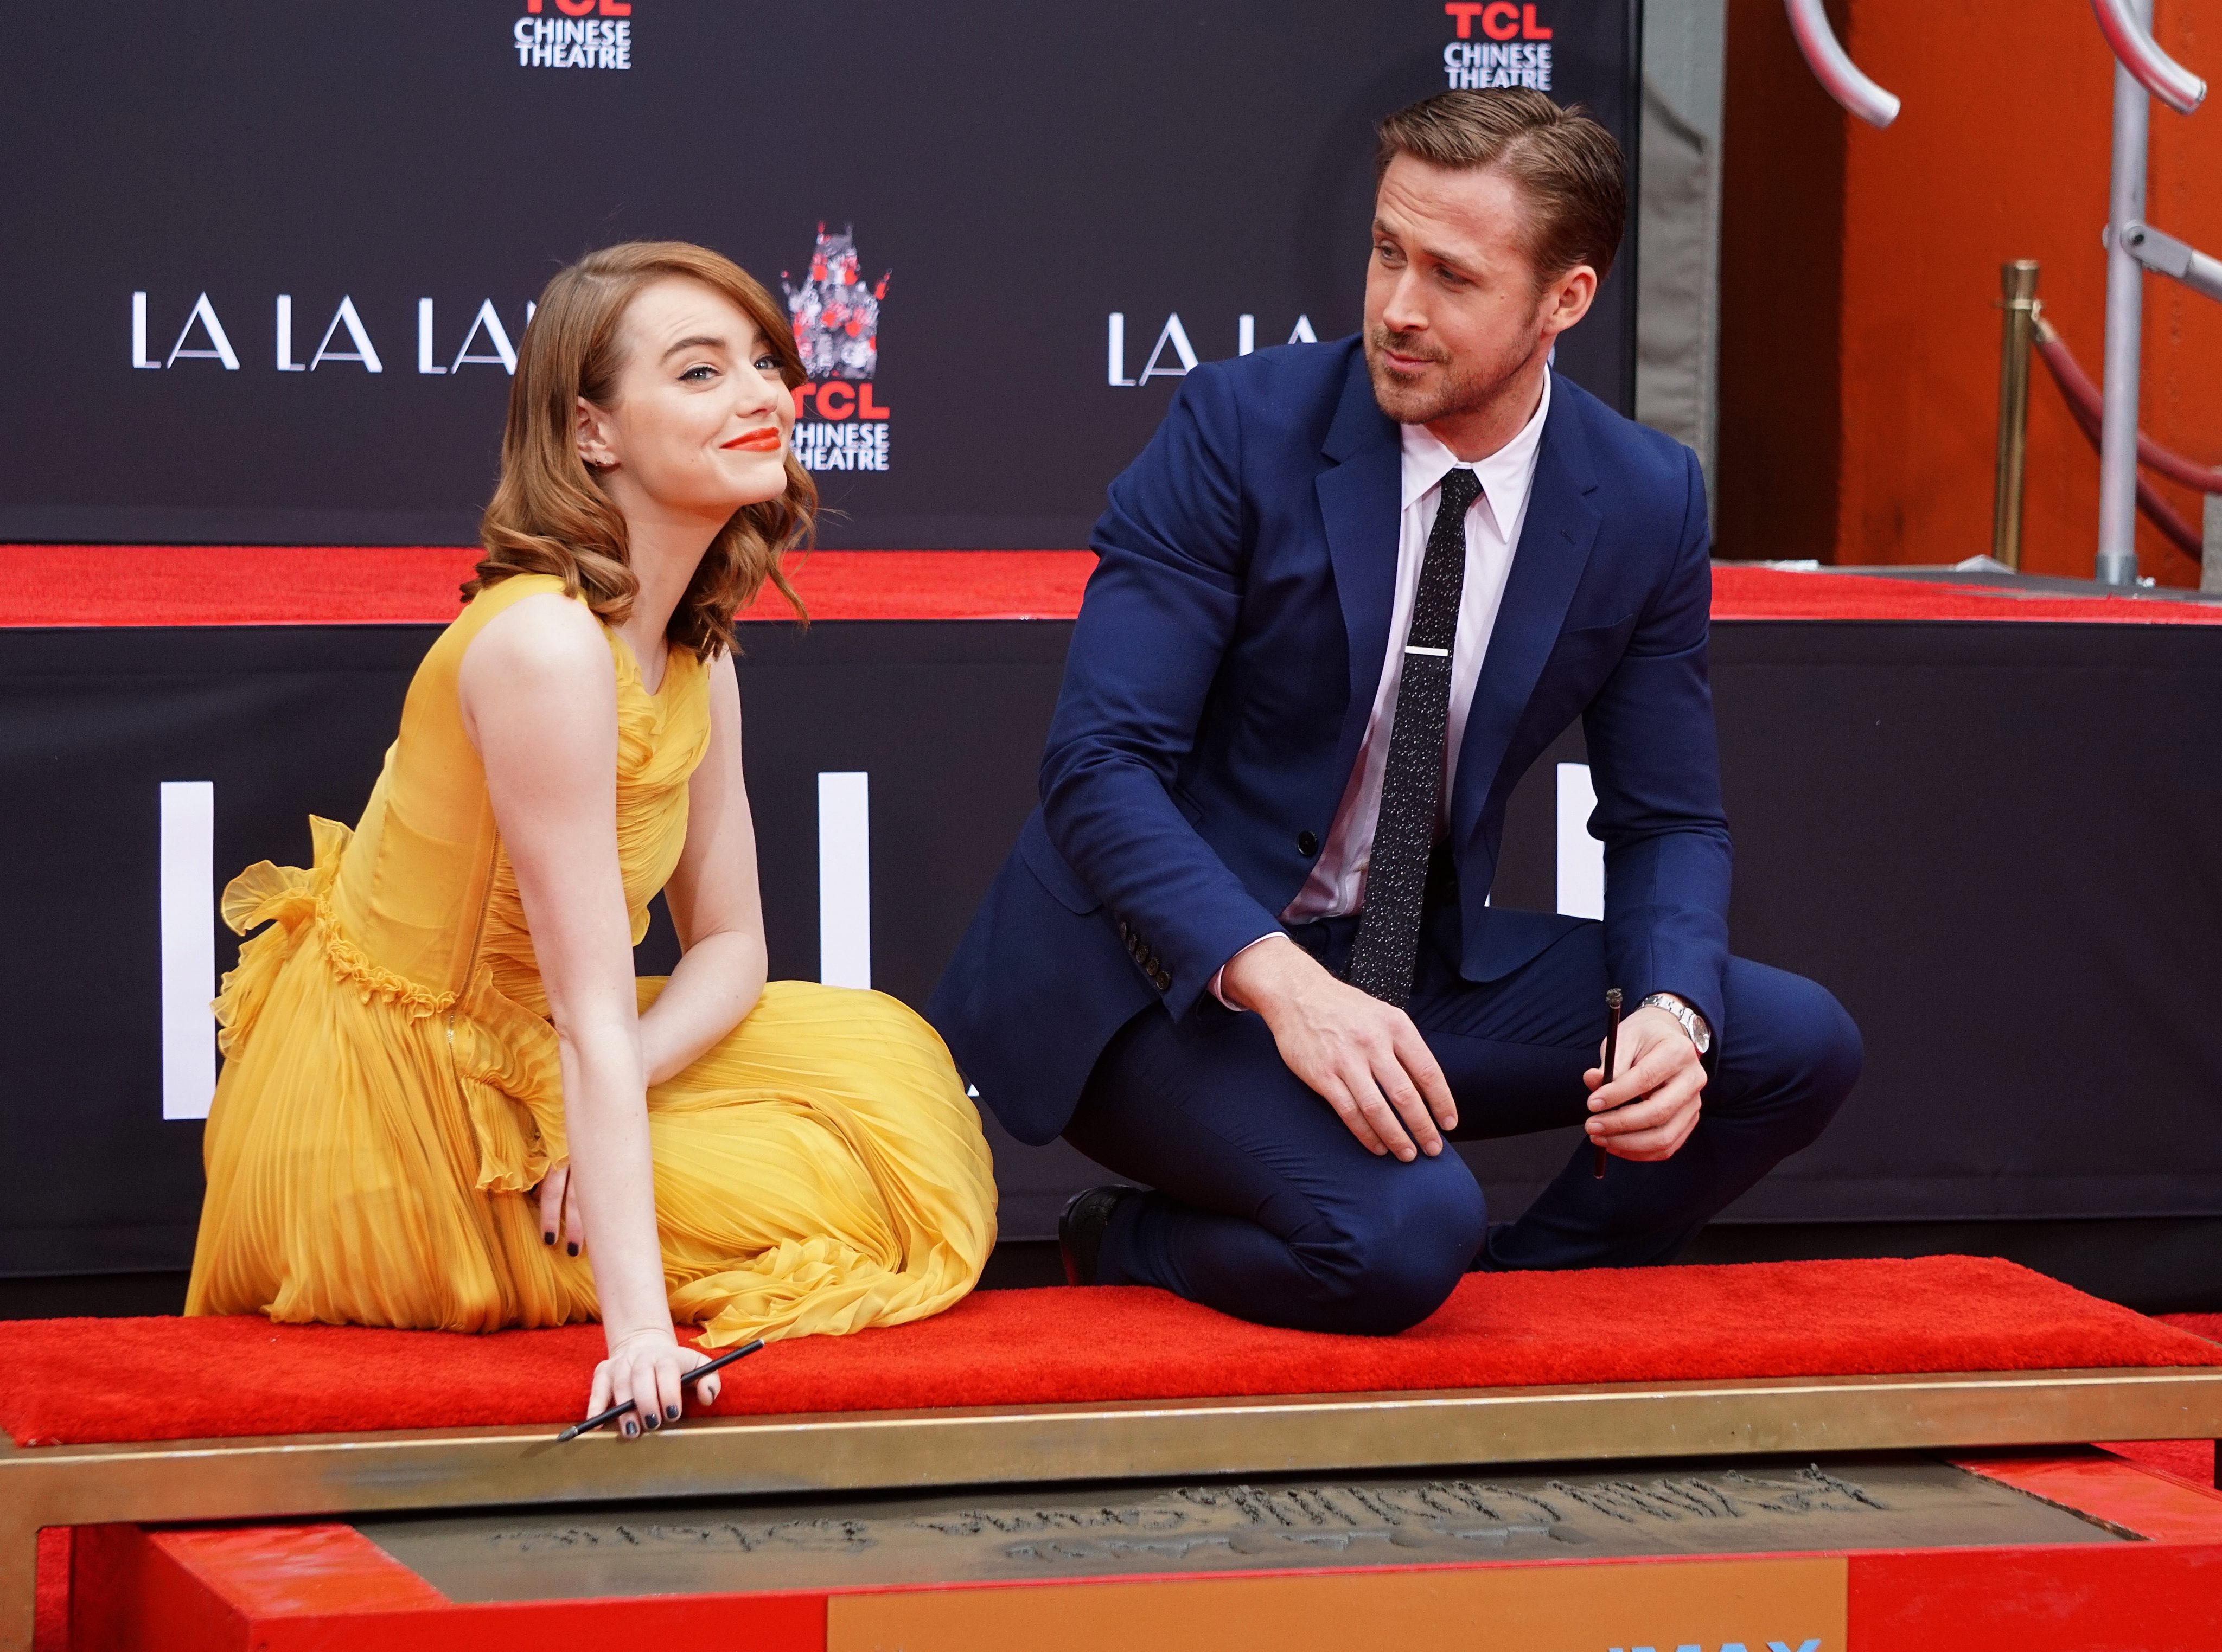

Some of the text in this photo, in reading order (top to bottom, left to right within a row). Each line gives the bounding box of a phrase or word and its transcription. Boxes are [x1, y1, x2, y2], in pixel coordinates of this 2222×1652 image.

[514, 17, 632, 46] CHINESE
[1444, 2, 1553, 41] TCL
[515, 42, 632, 69] THEATRE
[1444, 42, 1553, 69] CHINESE
[1444, 66, 1553, 91] THEATRE
[132, 291, 536, 375] LA LA LA
[1108, 312, 1199, 387] LA
[790, 422, 890, 448] HINESE
[793, 446, 890, 471] HEATRE
